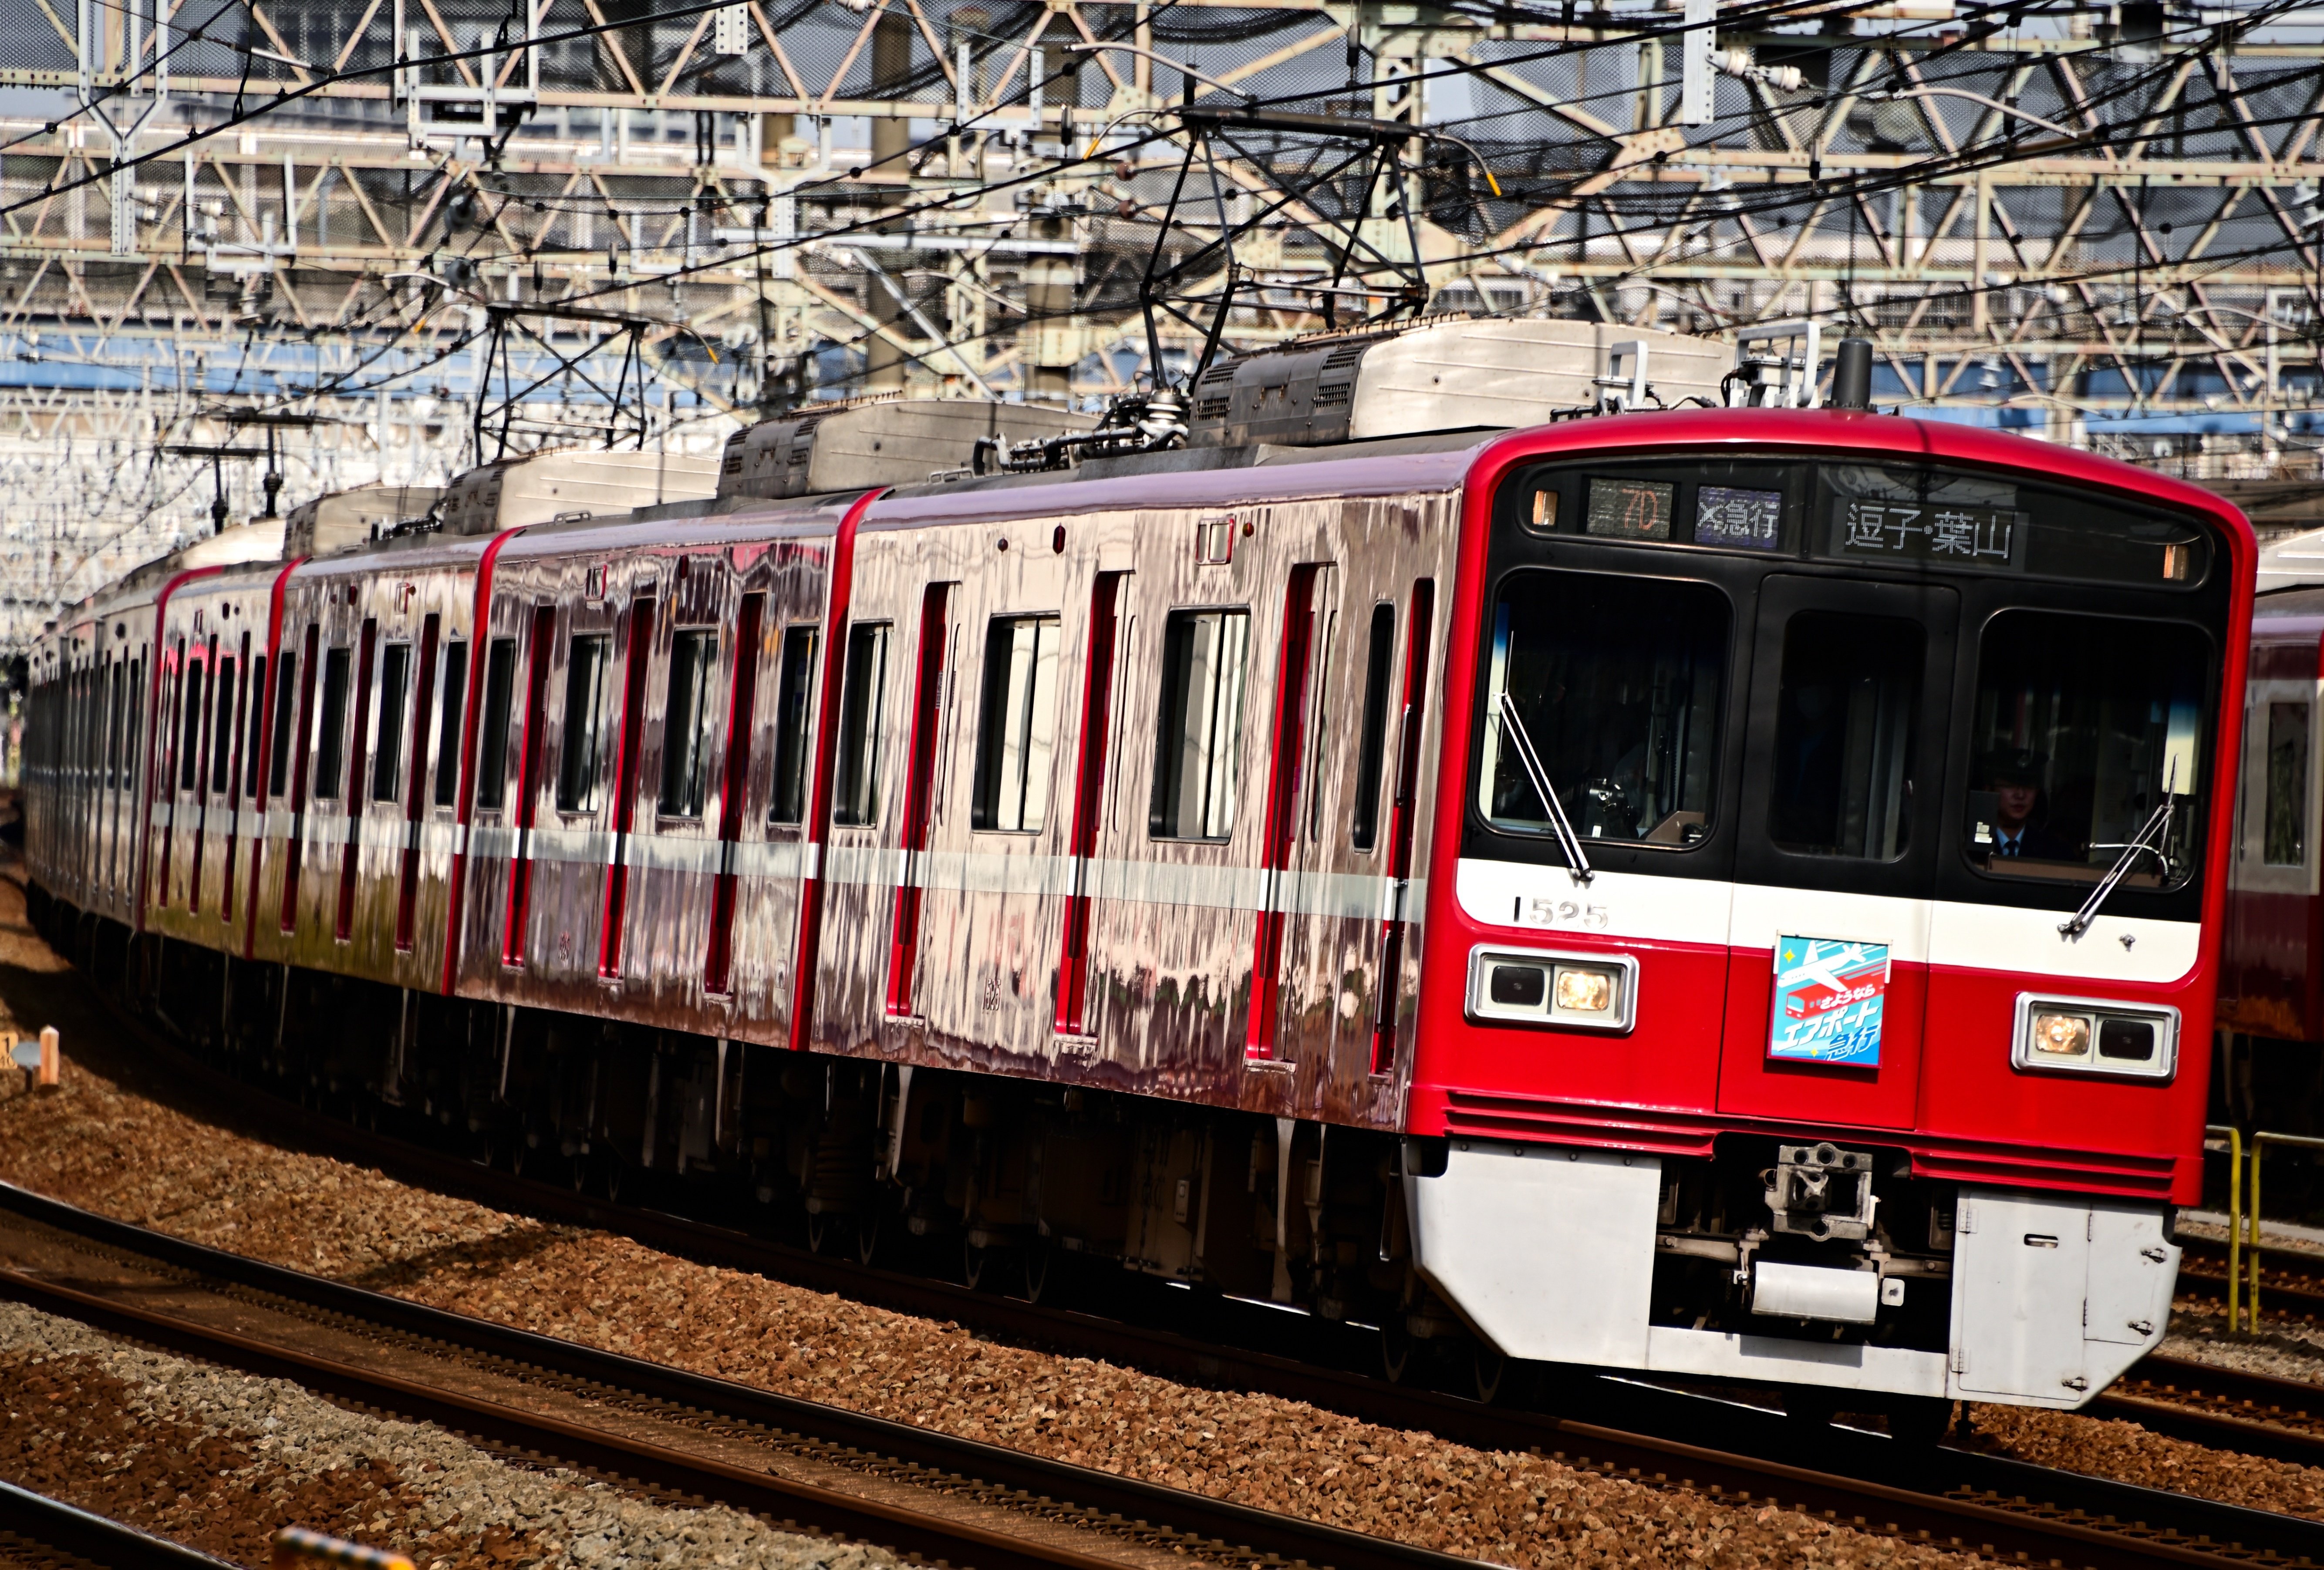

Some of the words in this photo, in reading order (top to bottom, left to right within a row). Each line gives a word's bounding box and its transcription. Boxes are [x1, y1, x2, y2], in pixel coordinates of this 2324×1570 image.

[1845, 502, 2011, 559] 逗子・葉山
[1514, 896, 1608, 929] 1525
[1820, 984, 1875, 1010] さようなら
[1777, 1001, 1880, 1052] エアポート
[1825, 1024, 1881, 1061] 急行
